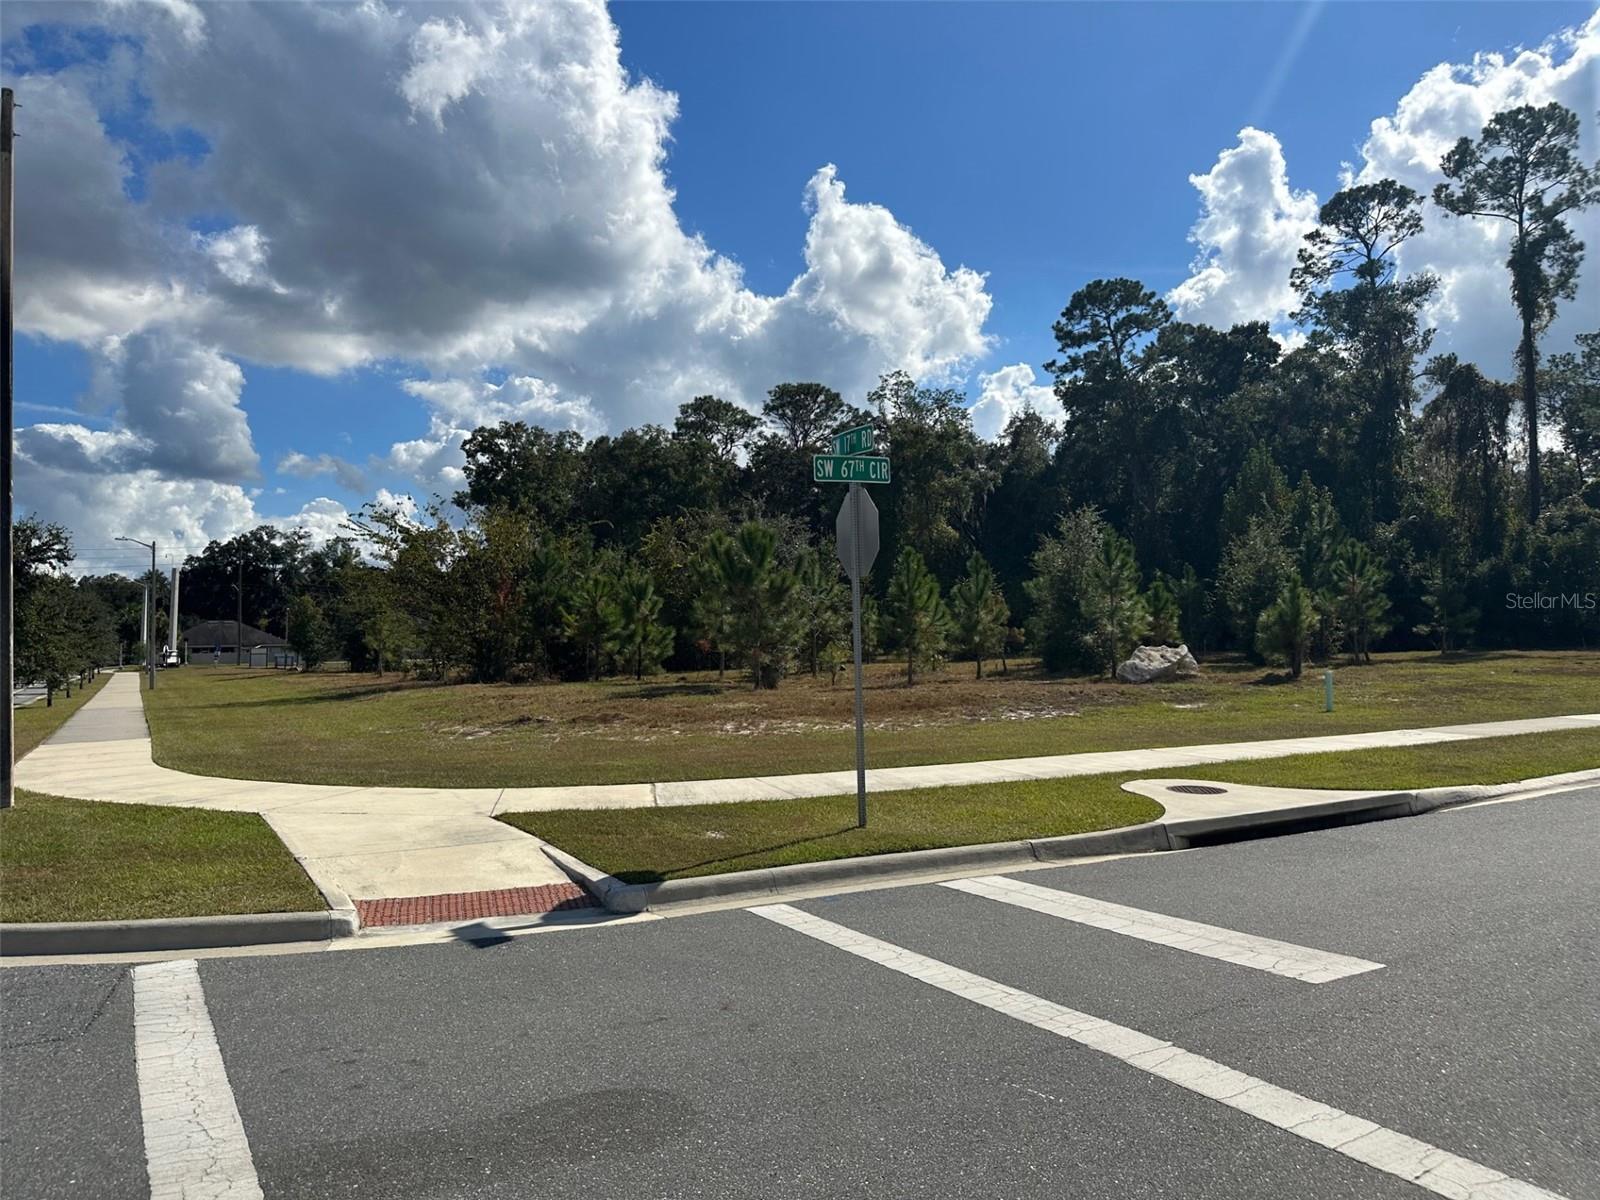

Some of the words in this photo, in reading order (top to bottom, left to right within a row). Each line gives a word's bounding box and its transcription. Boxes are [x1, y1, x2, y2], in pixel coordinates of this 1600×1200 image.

[861, 429, 872, 448] RD
[816, 459, 833, 477] SW
[841, 460, 864, 478] 67TH
[869, 461, 888, 479] CIR
